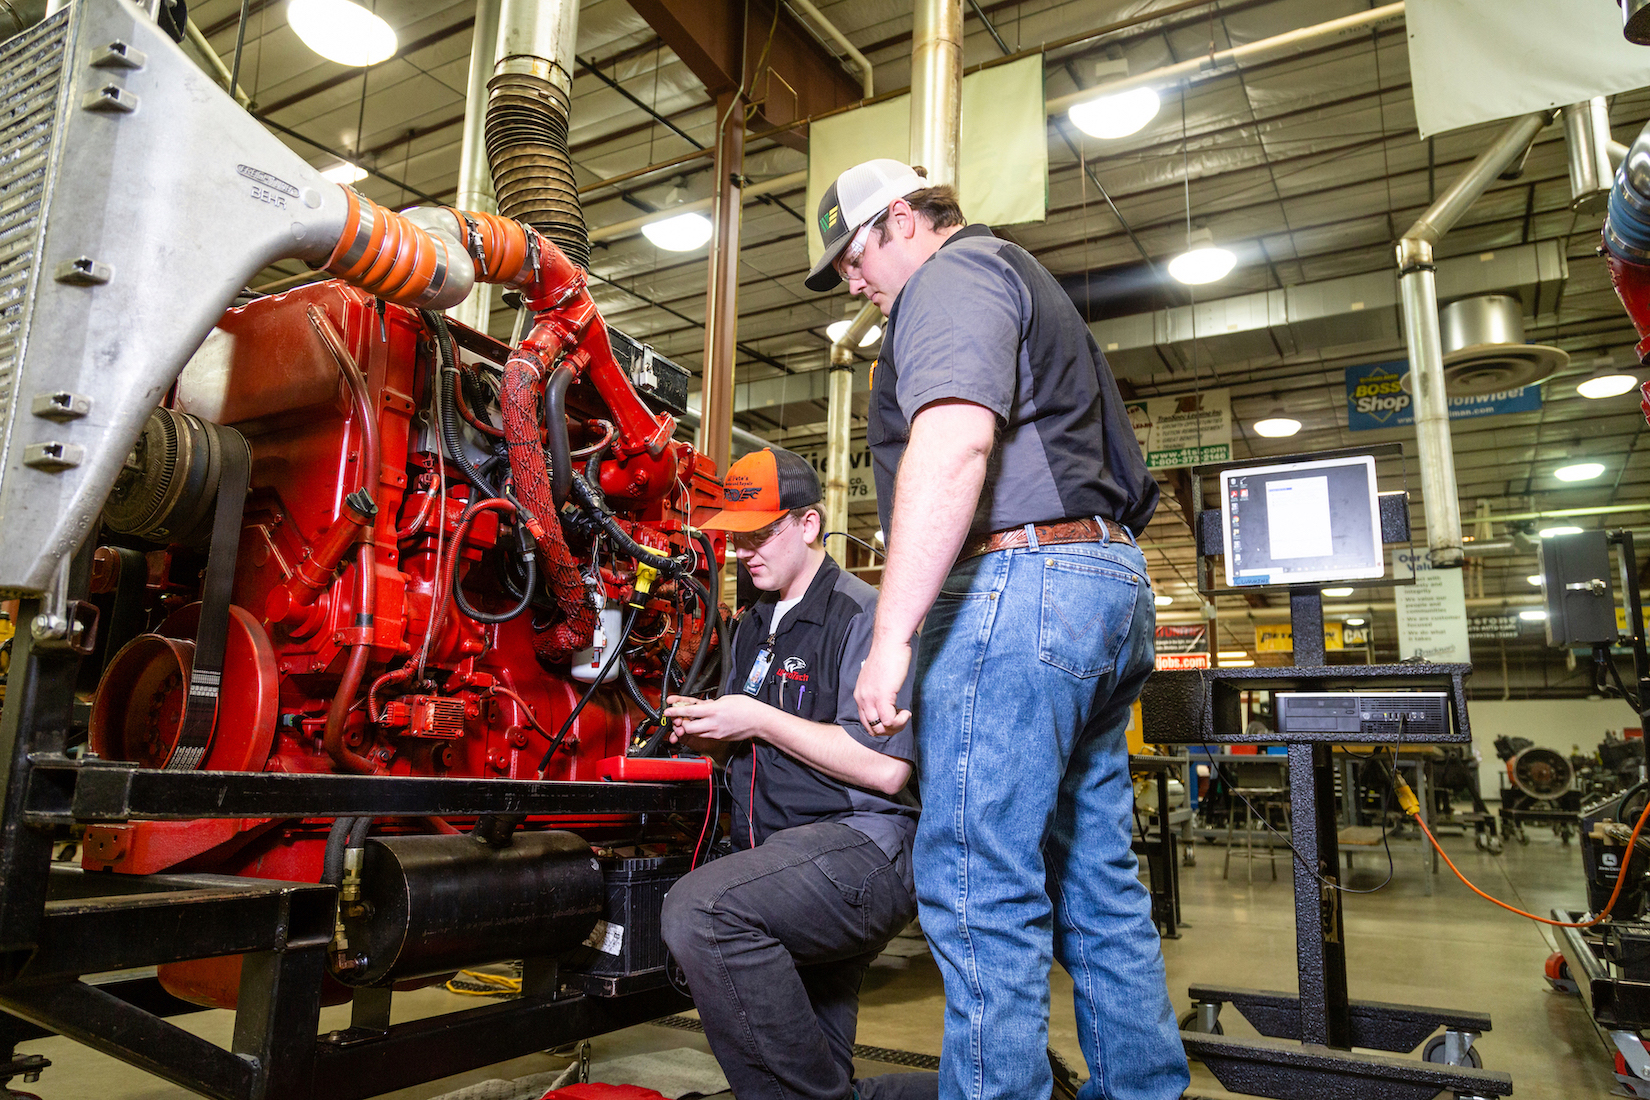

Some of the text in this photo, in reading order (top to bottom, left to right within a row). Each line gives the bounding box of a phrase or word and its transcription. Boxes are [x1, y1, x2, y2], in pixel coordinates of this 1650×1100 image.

[250, 185, 287, 210] BEHR
[1356, 381, 1402, 397] BOSS
[1357, 395, 1410, 413] Shop
[1344, 628, 1369, 644] CAT
